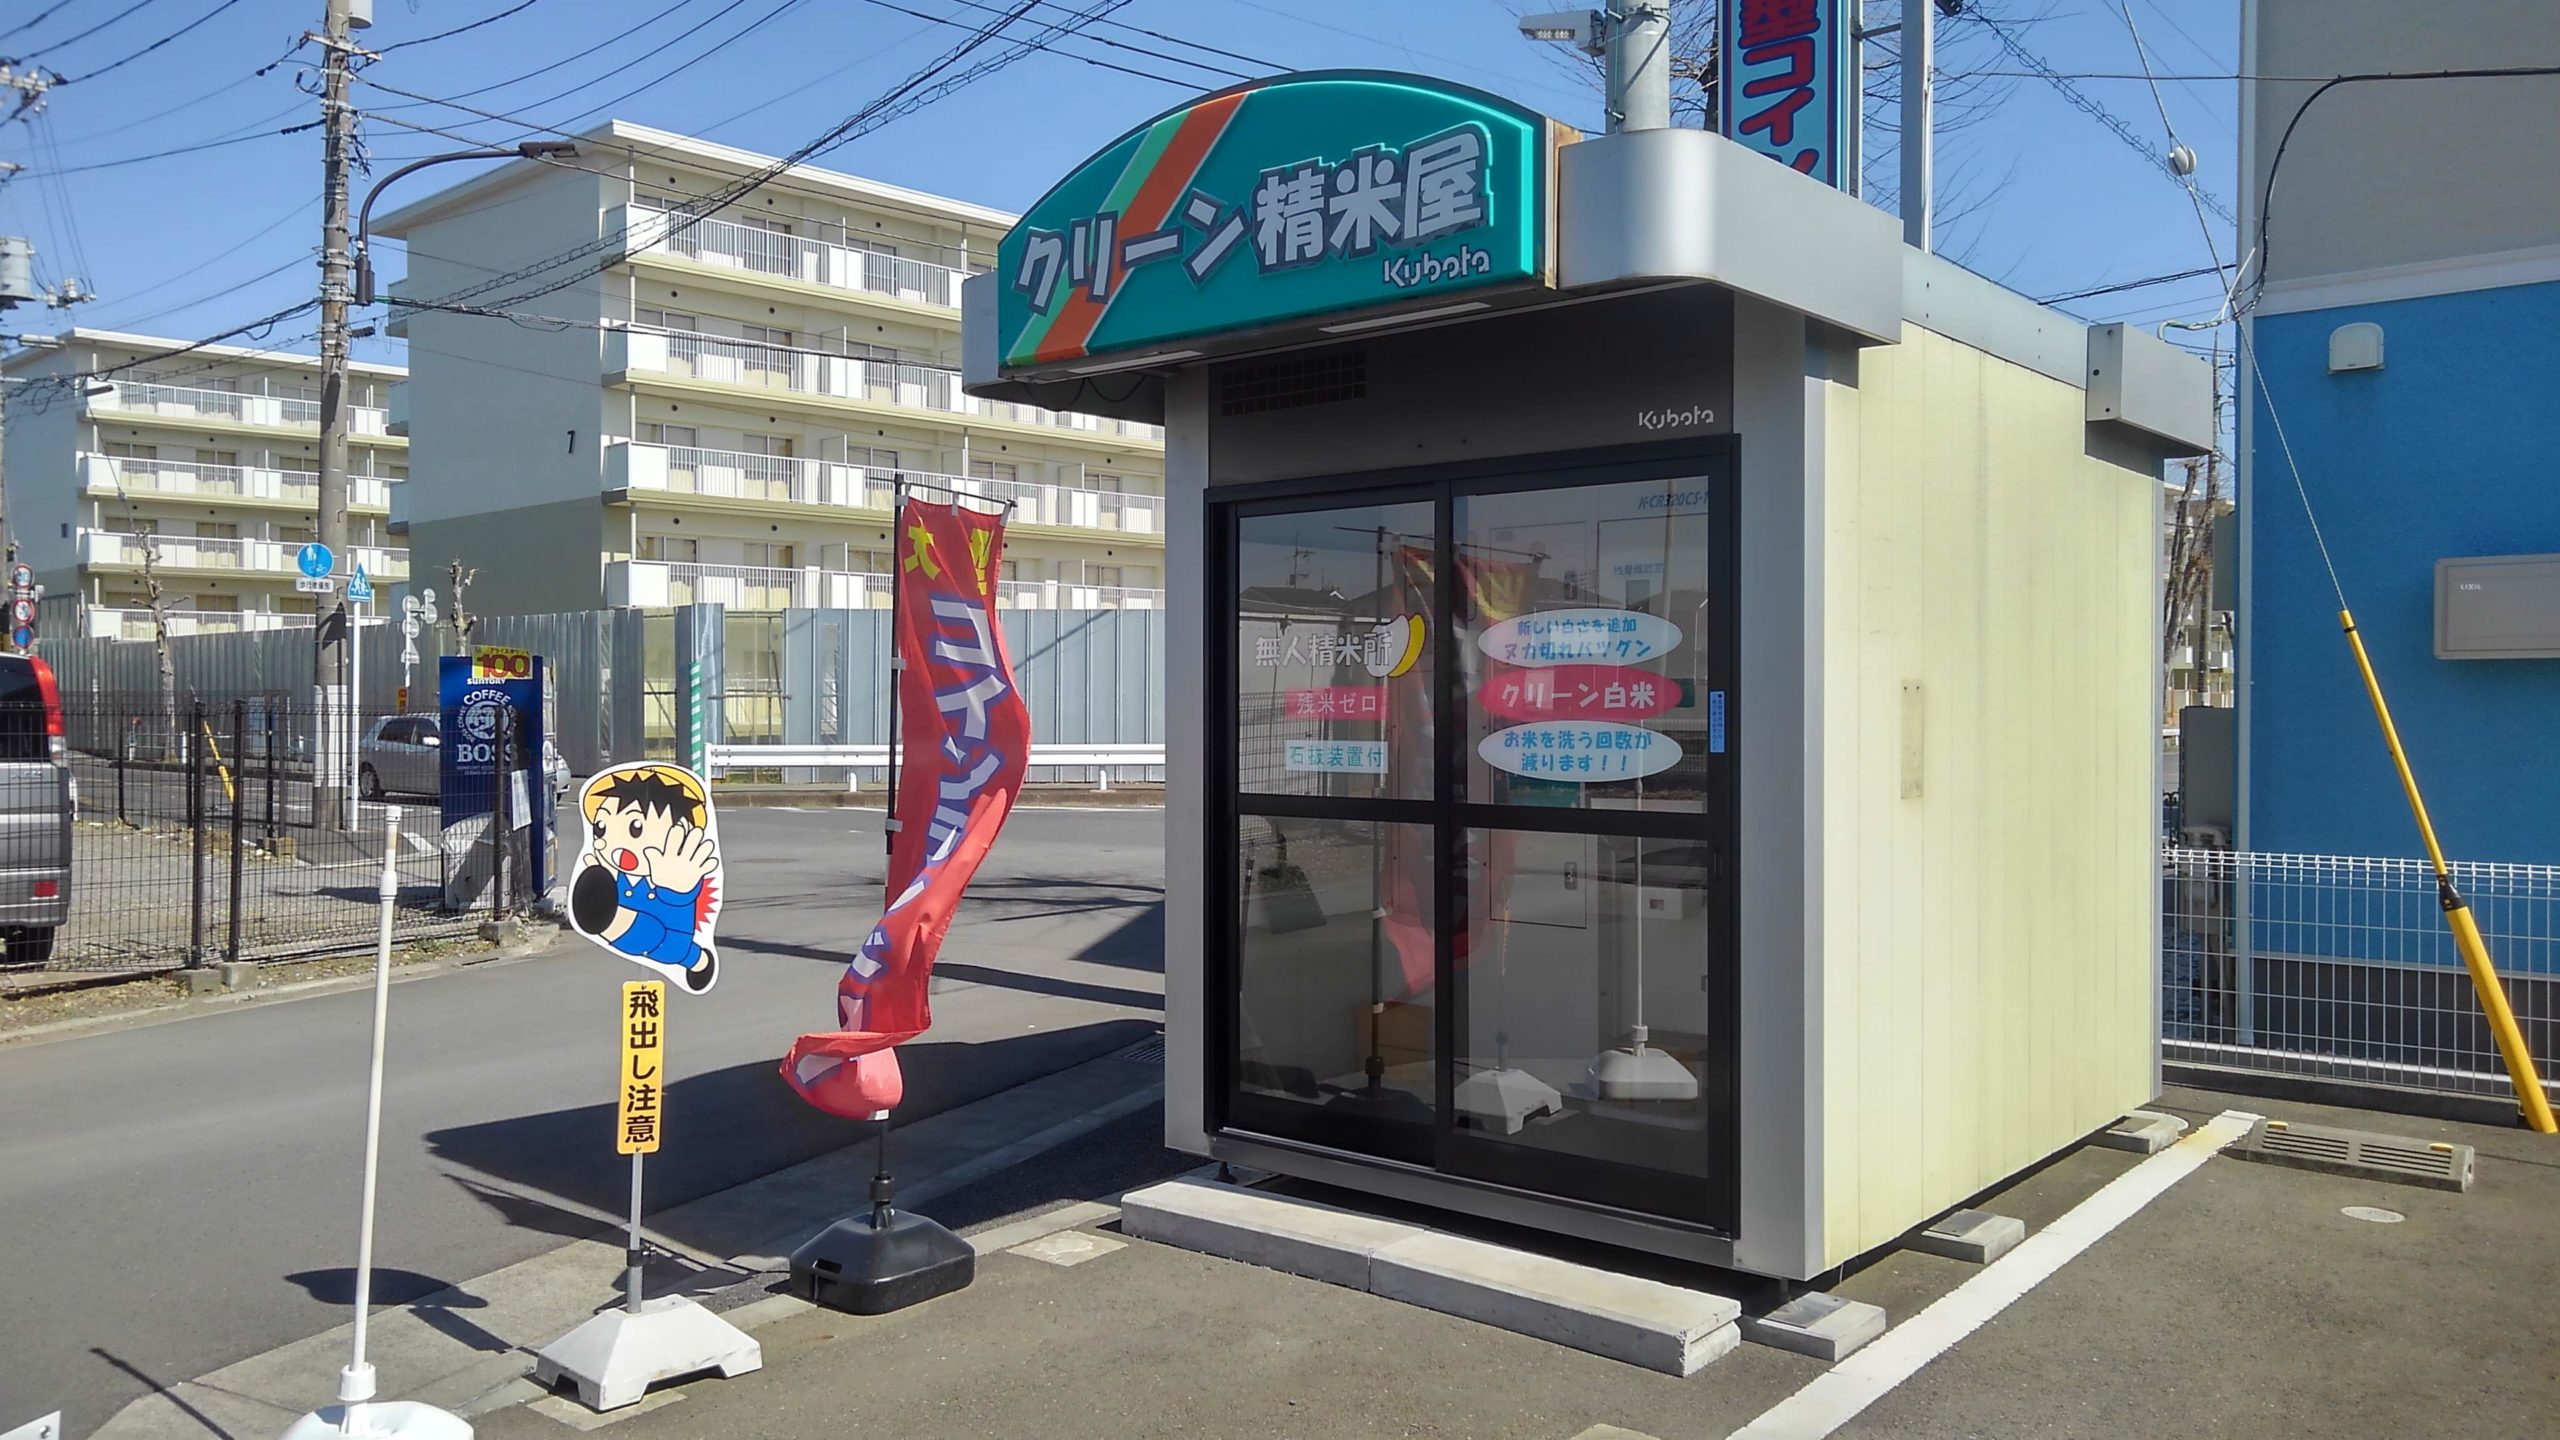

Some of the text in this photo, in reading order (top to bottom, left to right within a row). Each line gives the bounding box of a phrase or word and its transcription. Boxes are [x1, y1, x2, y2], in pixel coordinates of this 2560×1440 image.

[1014, 129, 1487, 313] クリーン精米屋
[1383, 246, 1491, 287] Kubota
[1639, 405, 1715, 430] Kubota
[1517, 616, 1637, 636] 新しい白さを追加
[1255, 631, 1393, 667] 無人精米所
[1505, 639, 1651, 660] ヌカ切れバツグン
[477, 654, 531, 678] 100
[463, 689, 512, 706] COFFEE
[1297, 690, 1377, 715] 残米ゼロ
[1501, 681, 1656, 710] クリーン白米
[1504, 730, 1653, 751] お米を洗う回数が
[1288, 745, 1384, 768] 石抜装置付
[1521, 752, 1630, 773] 減ります！！
[624, 989, 660, 1144] 飛出し注意
